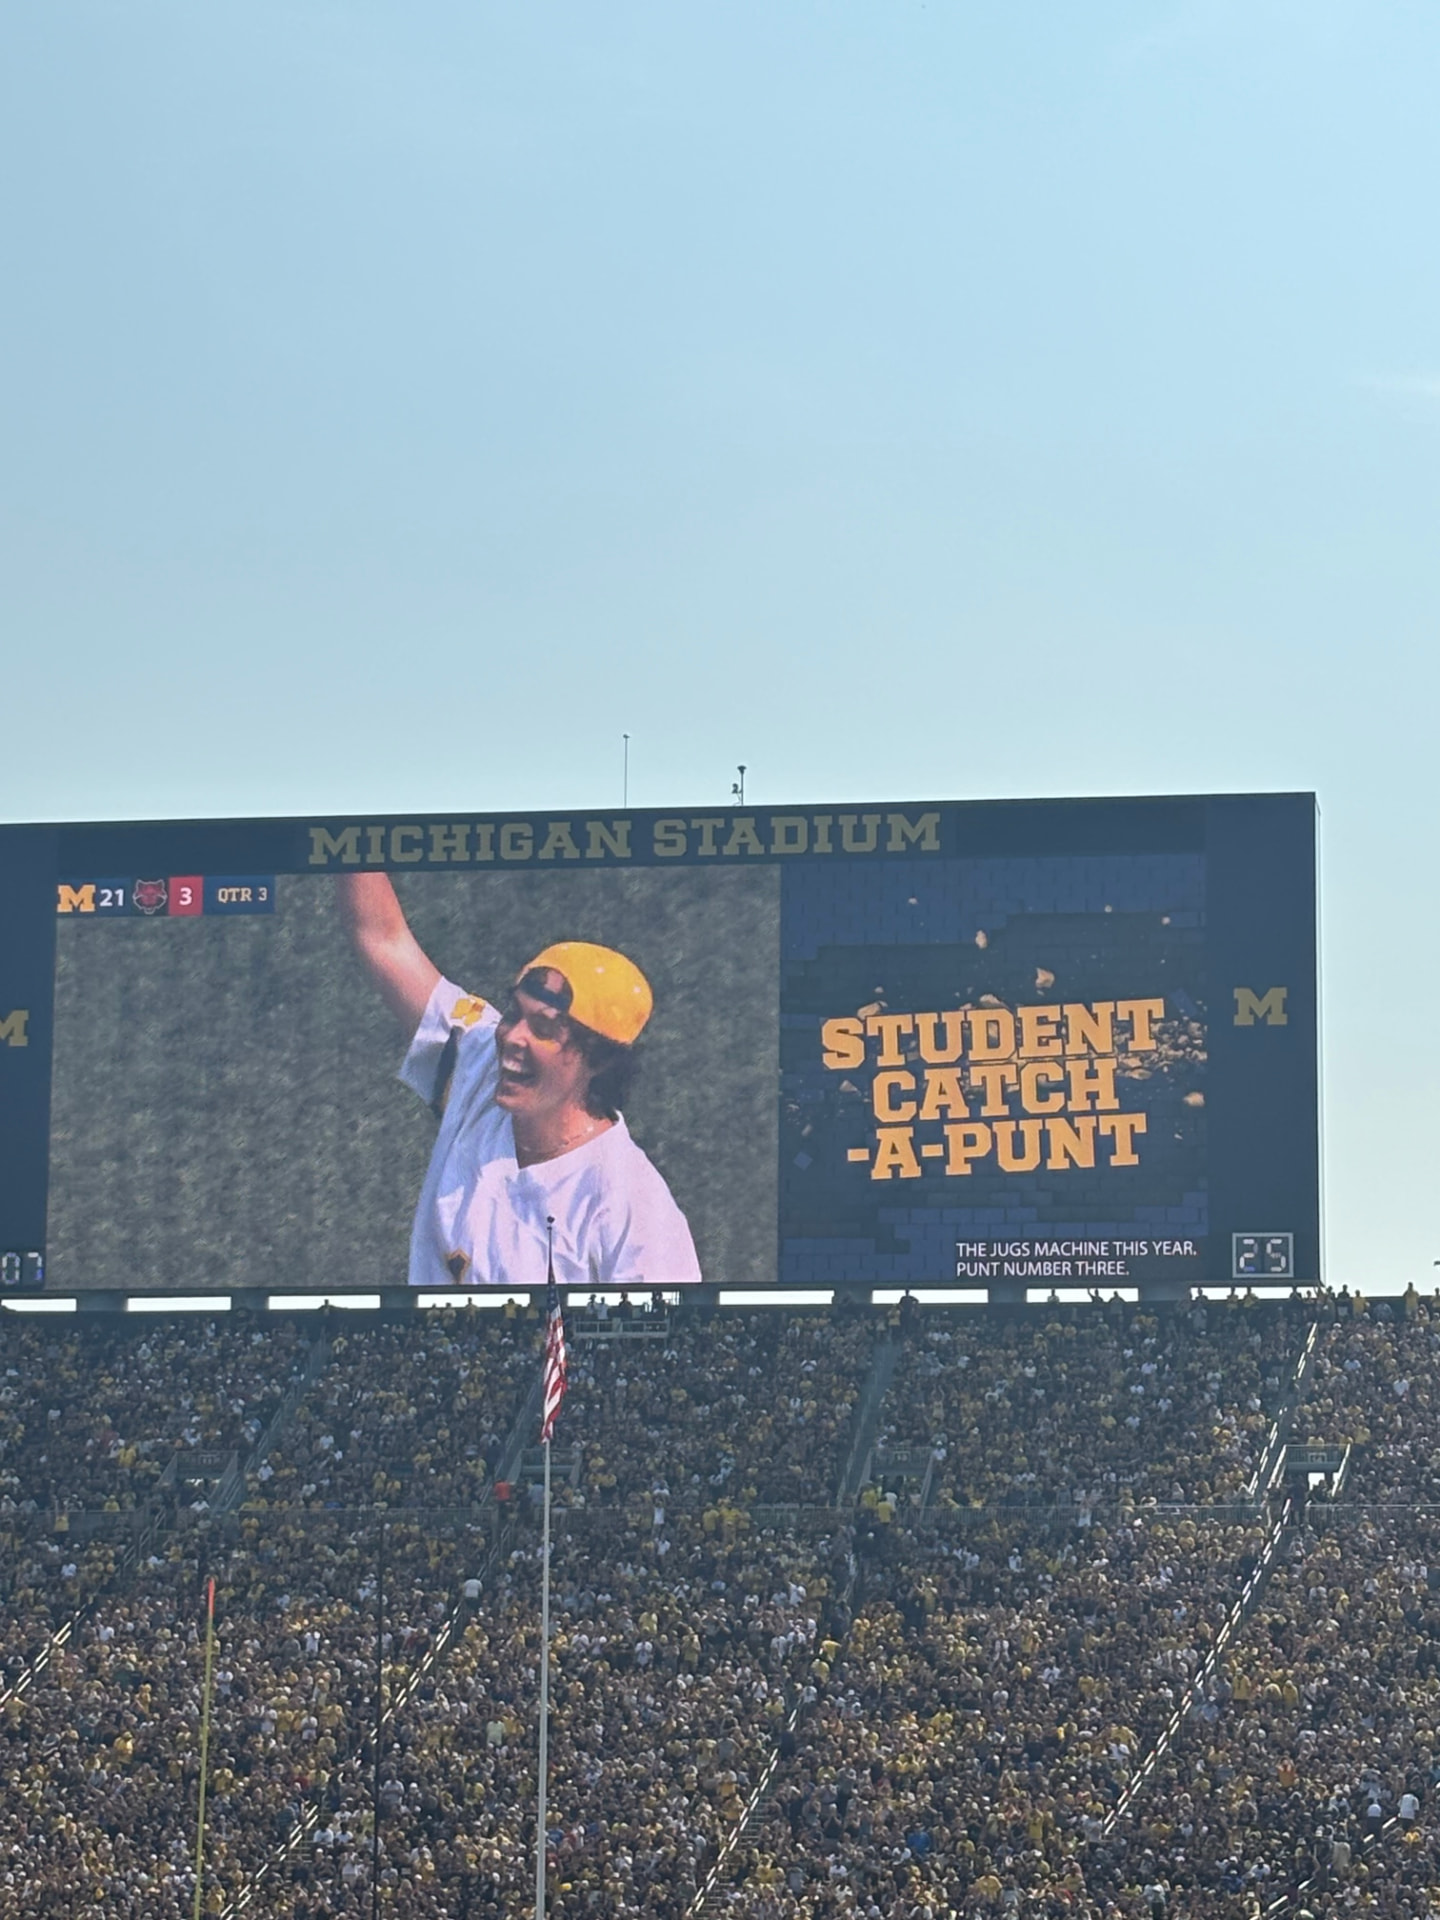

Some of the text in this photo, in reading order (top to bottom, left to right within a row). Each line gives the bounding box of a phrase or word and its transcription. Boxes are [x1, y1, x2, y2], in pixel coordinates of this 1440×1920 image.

[307, 812, 941, 865] MICHIGAN STADIUM
[56, 884, 268, 913] M 21 3 QTR 3
[1233, 986, 1288, 1026] M
[821, 998, 1165, 1071] STUDENT
[872, 1057, 1121, 1124] CATCH
[847, 1112, 1148, 1181] -A-PUNT
[955, 1240, 1197, 1258] THE JUGS MACHINE THIS YEAR.
[956, 1260, 1130, 1277] PUNT NUMBER THREE.
[1239, 1238, 1287, 1273] 25
